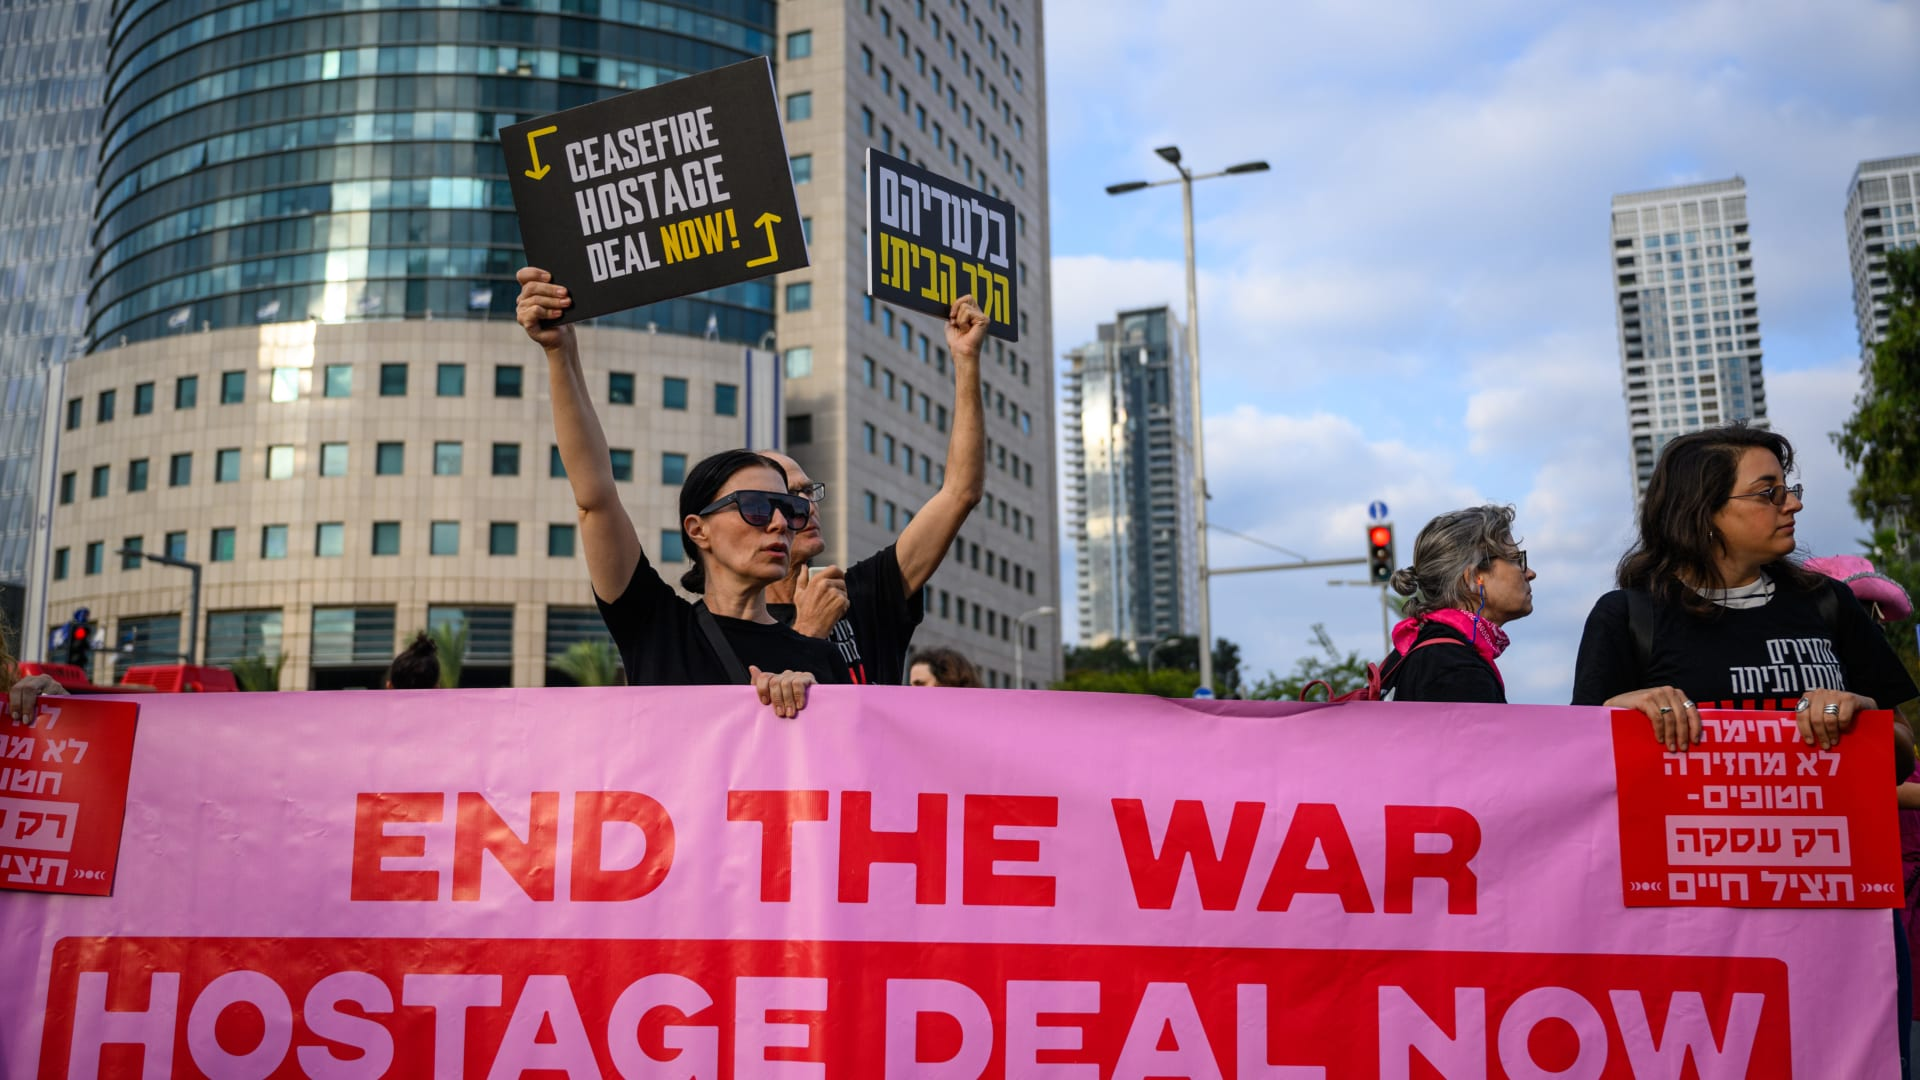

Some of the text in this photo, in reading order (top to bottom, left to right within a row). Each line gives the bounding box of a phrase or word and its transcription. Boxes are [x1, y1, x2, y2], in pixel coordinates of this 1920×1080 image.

[565, 106, 719, 183] CEASEFIRE
[575, 154, 731, 236] HOSTAGE
[879, 166, 1009, 269] בלעדיהם
[586, 208, 741, 283] DEAL NOW!
[879, 231, 1011, 326] הלך הבית!
[1766, 638, 1839, 664] מחזירים
[1729, 664, 1799, 694] הביתה
[42, 738, 89, 765] לא
[1663, 750, 1841, 776] לא מחזירה
[1687, 785, 1824, 809] חטופים-
[15, 810, 68, 840] רק
[351, 790, 1481, 915] END THE WAR
[1675, 827, 1841, 858] רק עסקה
[1668, 870, 1855, 901] תציל חיים
[68, 970, 1765, 1080] HOSTAGE DEAL NOW
